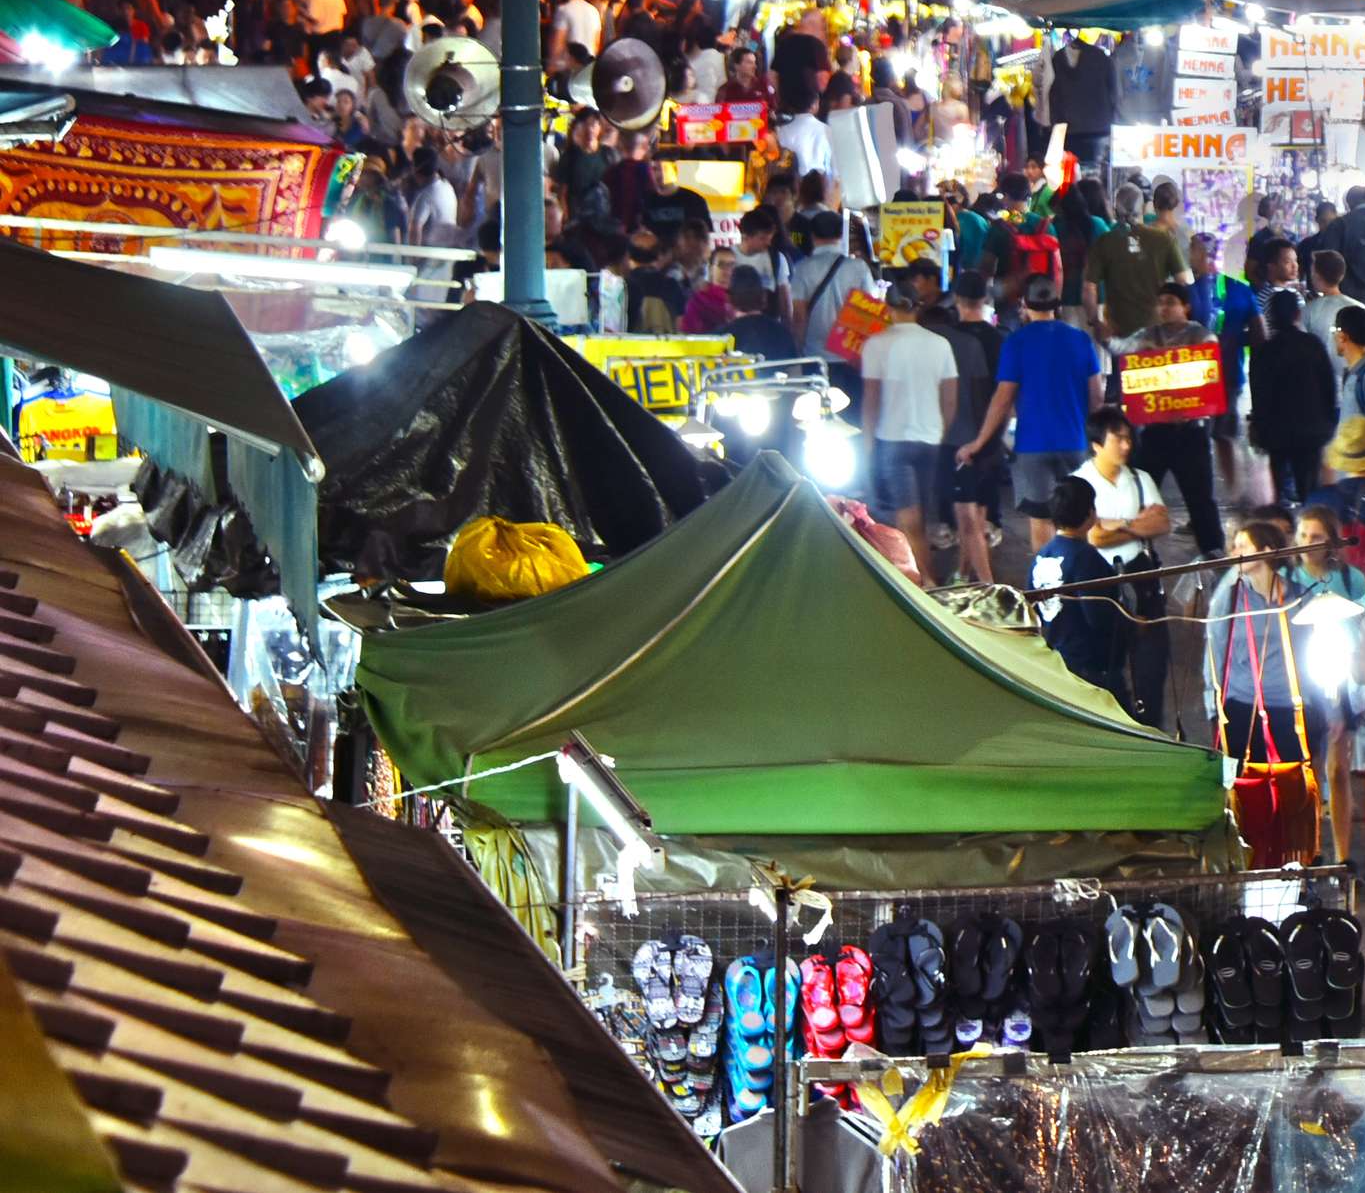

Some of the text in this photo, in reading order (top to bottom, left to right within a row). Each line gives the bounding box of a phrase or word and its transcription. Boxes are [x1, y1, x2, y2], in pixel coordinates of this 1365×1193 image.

[1183, 57, 1225, 73] HENNA
[1141, 132, 1248, 161] HENNA
[1125, 347, 1215, 369] Roof Bar
[1143, 392, 1156, 413] 3
